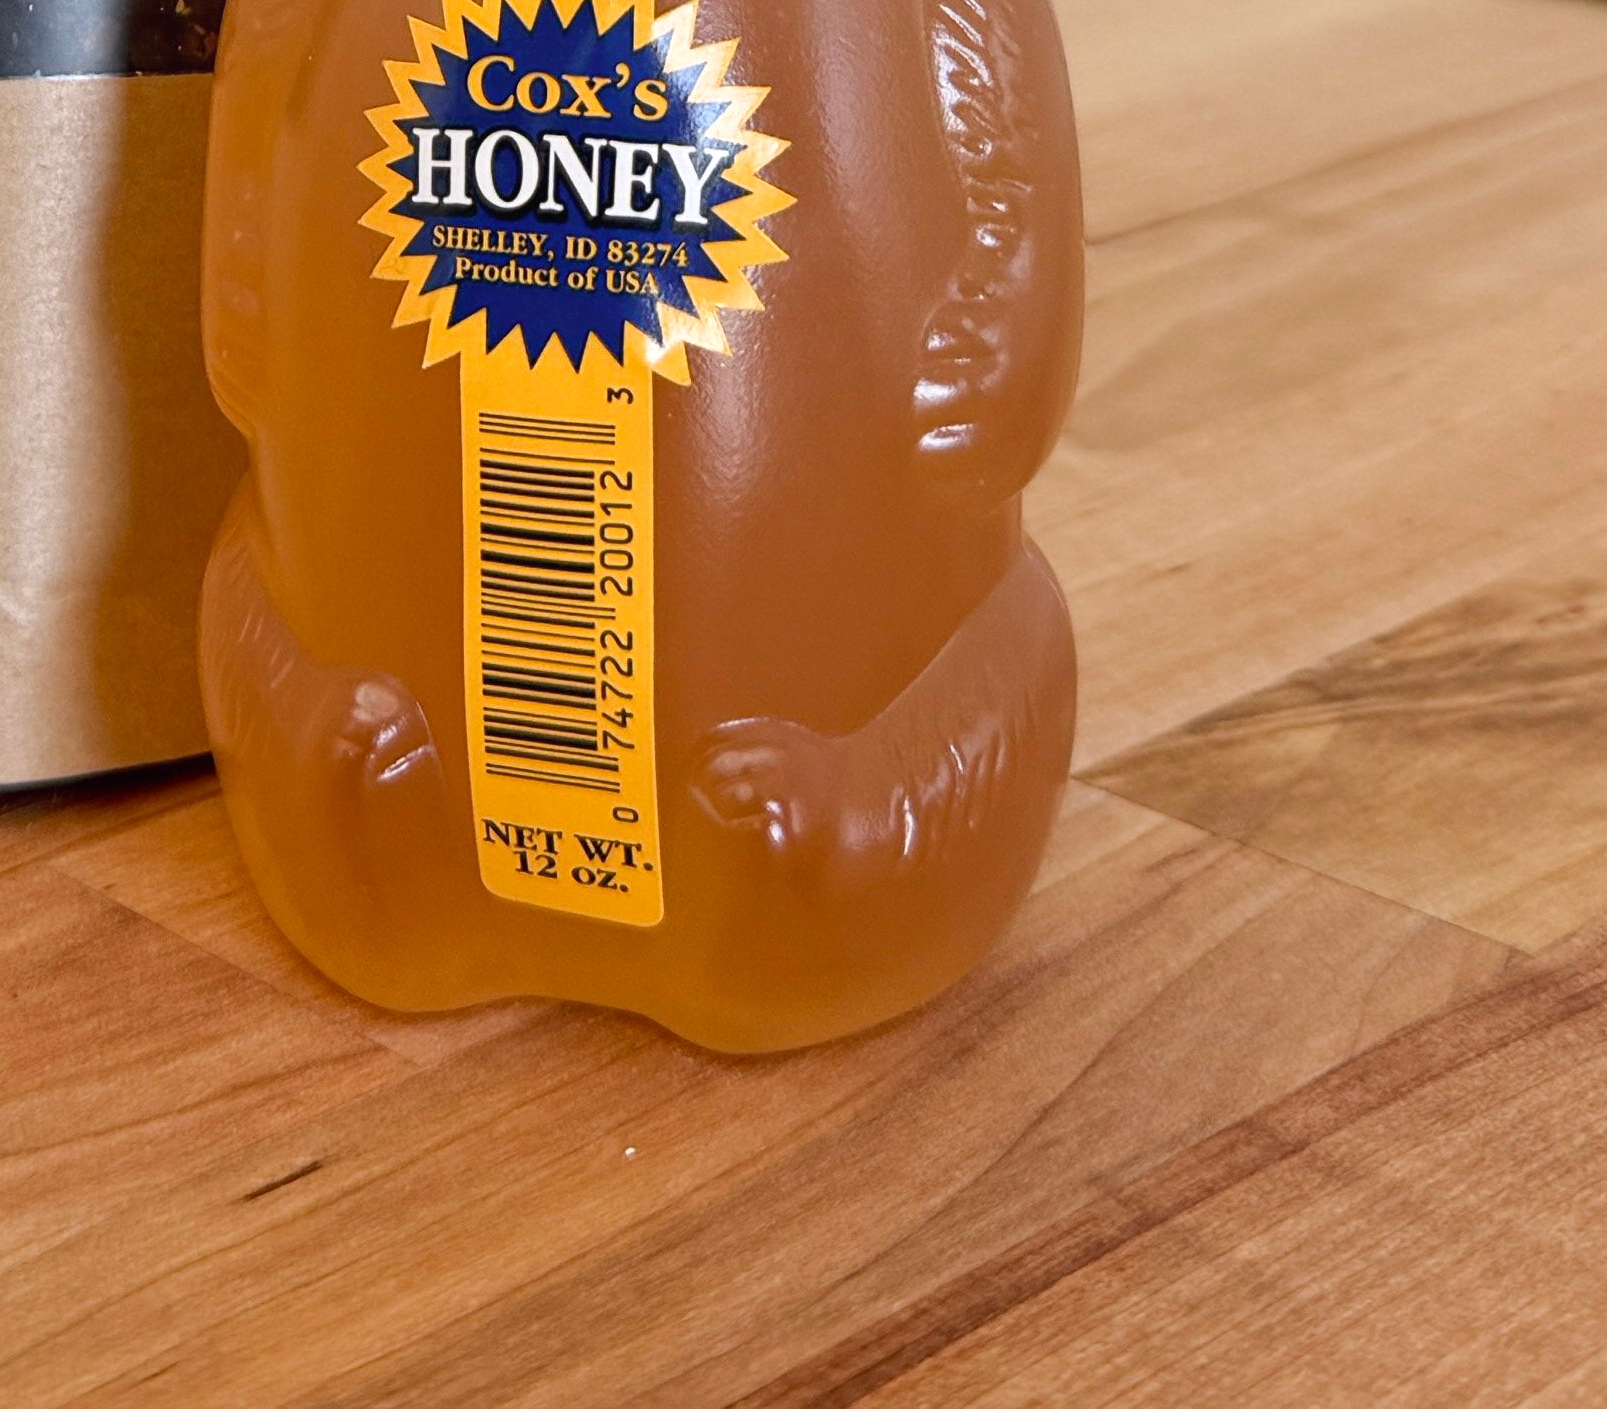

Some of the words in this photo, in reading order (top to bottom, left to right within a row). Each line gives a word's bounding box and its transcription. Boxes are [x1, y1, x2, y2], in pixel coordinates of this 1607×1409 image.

[411, 126, 731, 226] HONEY
[431, 224, 555, 262] SHELLEY,
[565, 236, 598, 261] ID
[605, 238, 689, 267] 83274
[454, 256, 559, 288] Product
[567, 266, 597, 290] of
[605, 271, 660, 296] USA
[607, 387, 634, 405] 3
[599, 470, 634, 597] 20012
[600, 630, 635, 750] 74722
[612, 807, 639, 824] 0
[482, 819, 563, 856] NET
[574, 834, 653, 872] WT.
[513, 850, 557, 879] 12
[571, 867, 629, 893] oz.
